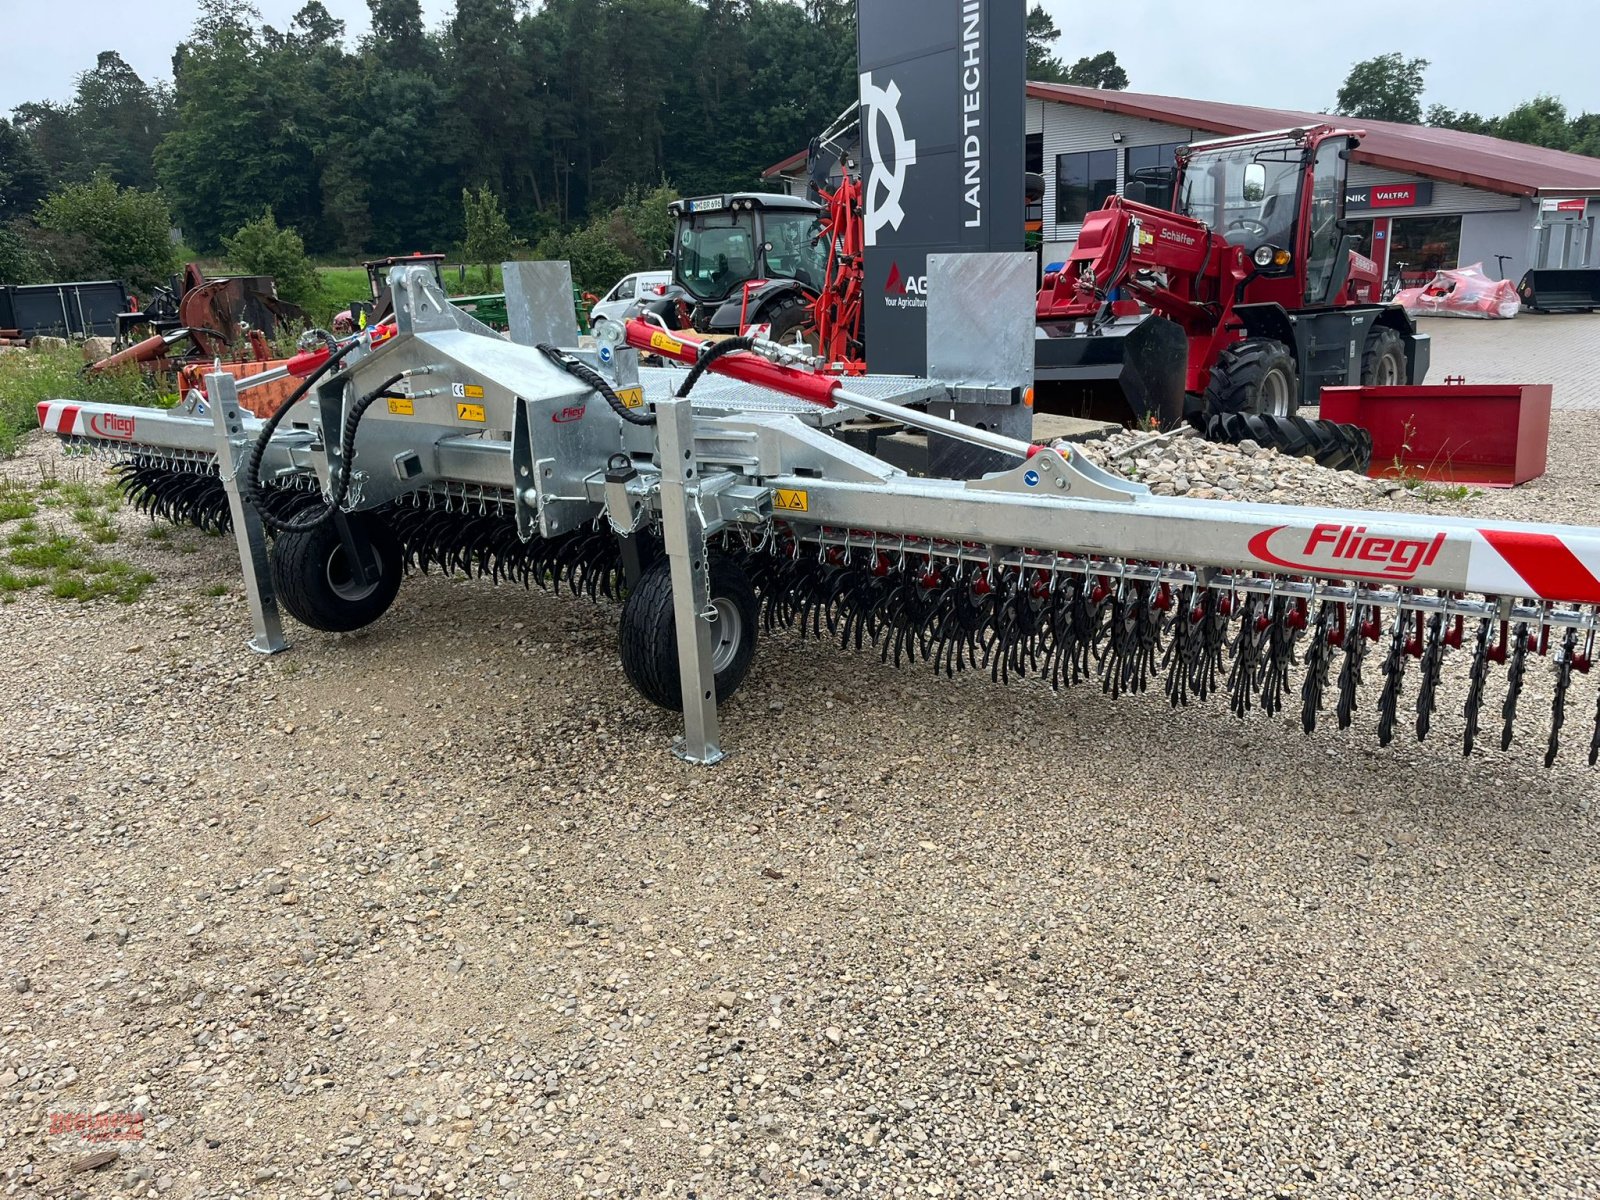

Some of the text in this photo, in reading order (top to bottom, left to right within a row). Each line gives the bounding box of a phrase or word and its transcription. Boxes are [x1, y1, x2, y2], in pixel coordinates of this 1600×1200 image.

[963, 0, 981, 228] LANDTECHNI
[1345, 191, 1409, 203] NIK VALTRA
[1160, 227, 1196, 246] Schäffer
[885, 296, 897, 306] Your
[562, 403, 586, 419] Fliegl
[103, 412, 135, 436] Fliegl
[1302, 523, 1448, 573] Fliegl
